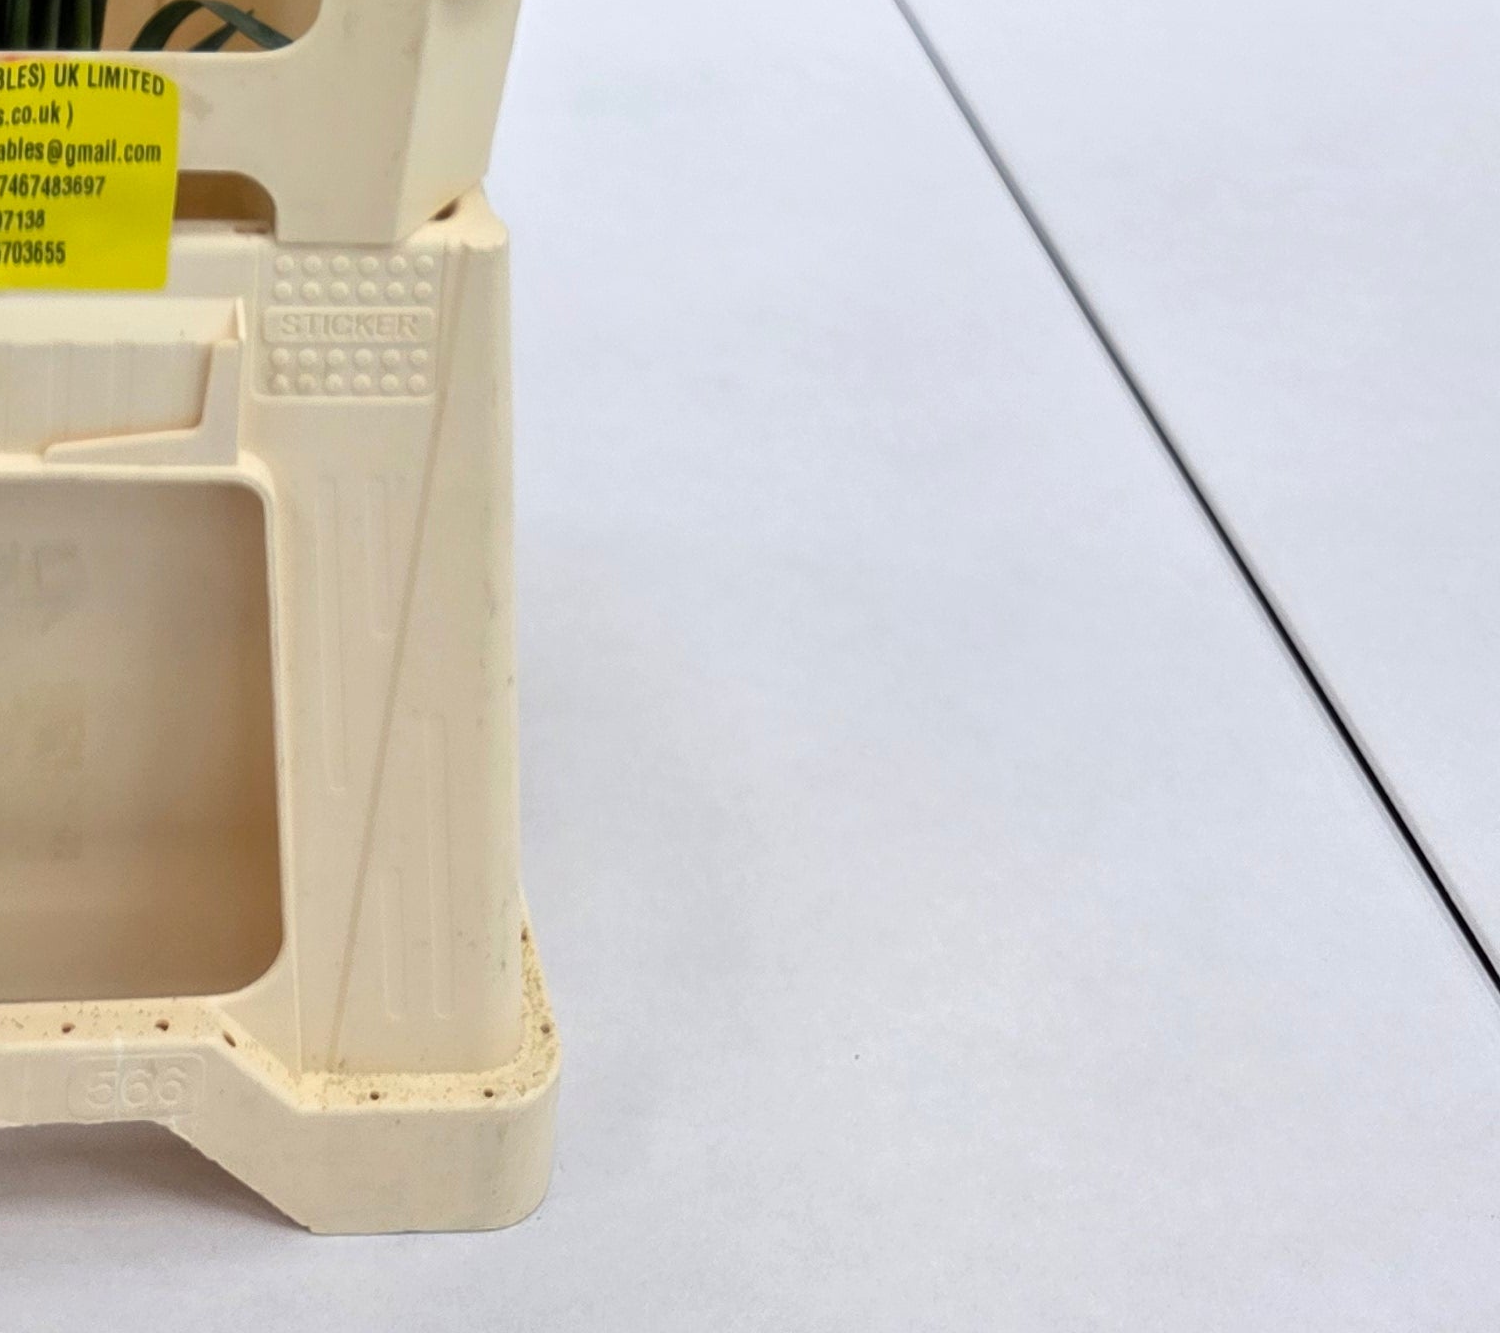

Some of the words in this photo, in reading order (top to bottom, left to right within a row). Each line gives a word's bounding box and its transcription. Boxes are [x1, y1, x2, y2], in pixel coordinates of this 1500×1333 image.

[53, 63, 80, 88] UK
[87, 64, 165, 96] LIMITED
[282, 313, 419, 336] STICKER
[86, 1065, 188, 1109] 566
